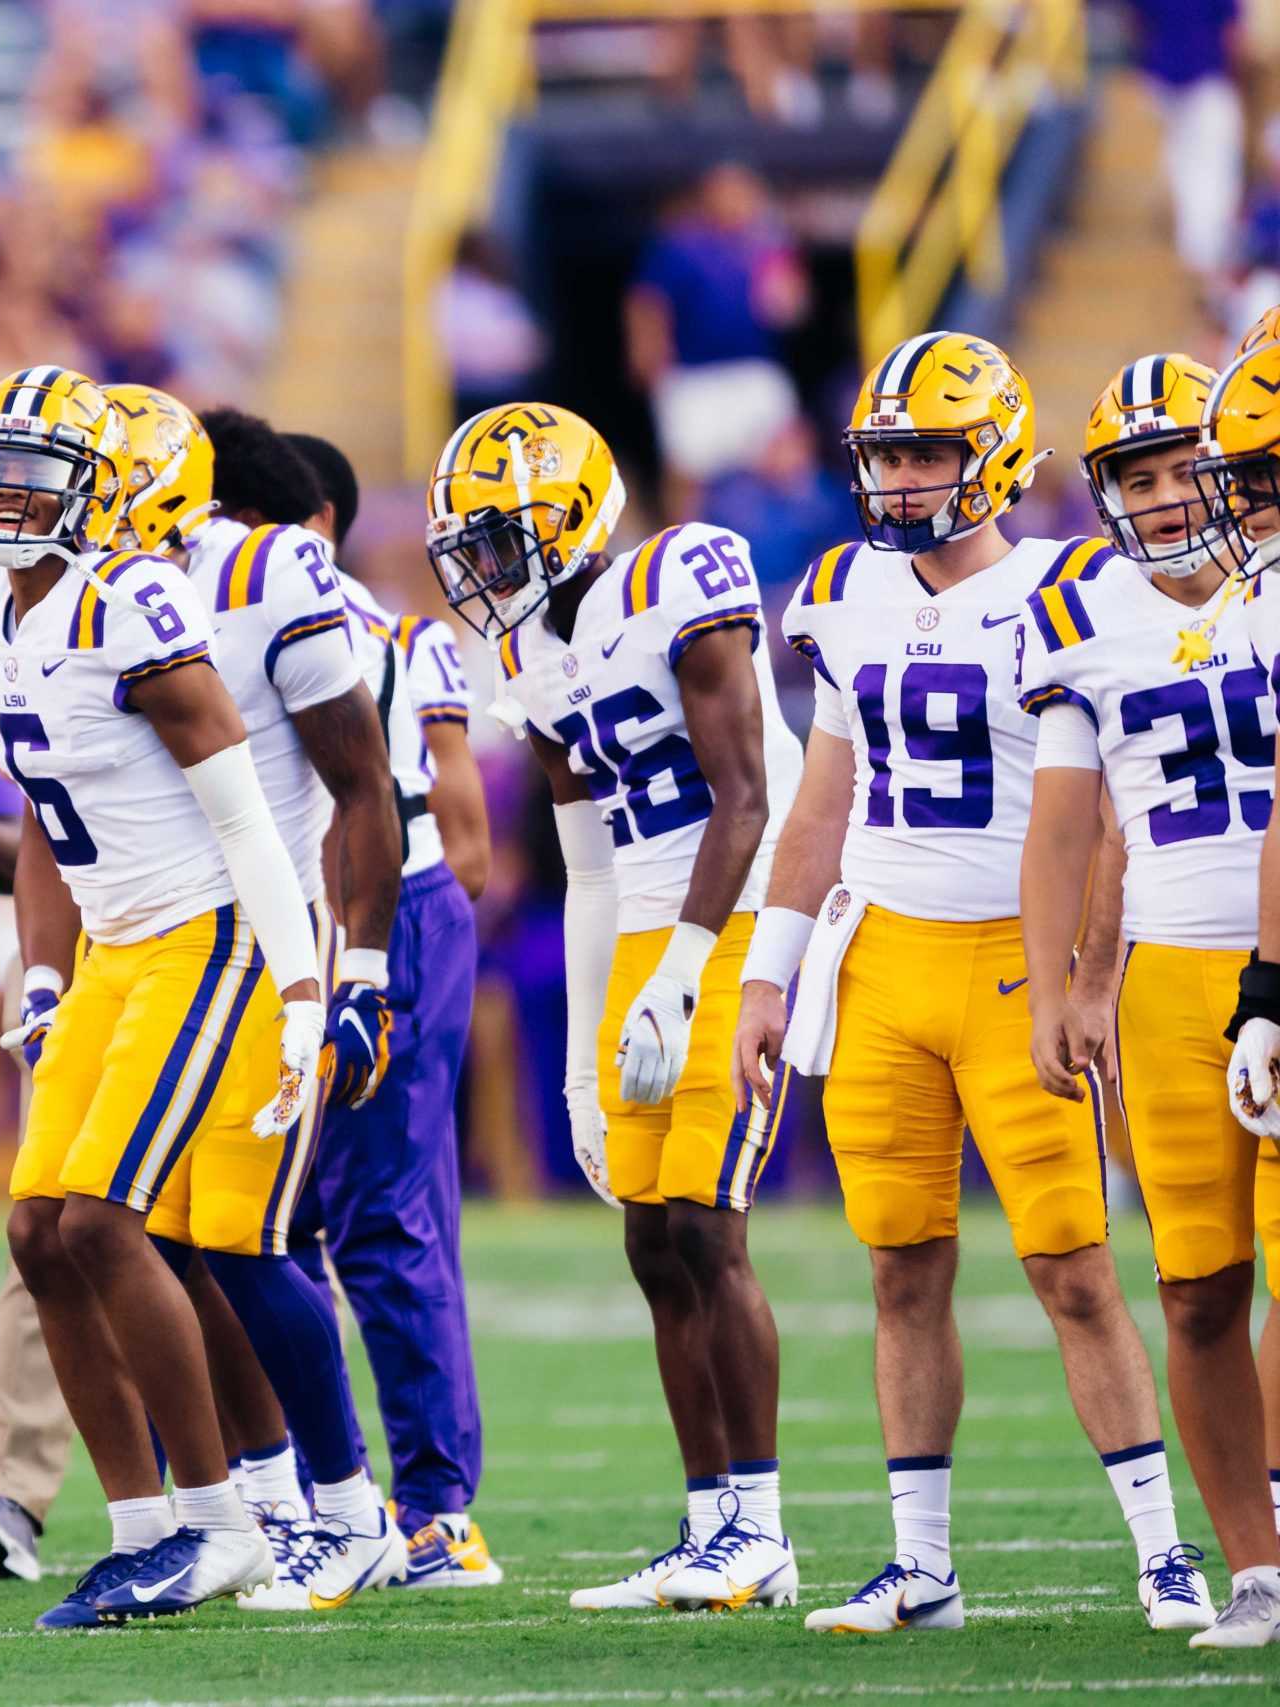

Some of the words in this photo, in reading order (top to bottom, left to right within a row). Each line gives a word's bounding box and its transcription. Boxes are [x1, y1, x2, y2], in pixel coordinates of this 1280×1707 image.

[1, 418, 32, 430] LSU
[871, 415, 896, 426] LSU
[295, 539, 340, 597] 2
[681, 535, 751, 600] 26
[135, 582, 185, 643] 6
[906, 642, 943, 656] LSU
[3, 695, 26, 707] LSU
[567, 684, 592, 705] LSU
[853, 663, 994, 829] 19
[552, 684, 716, 848] 26
